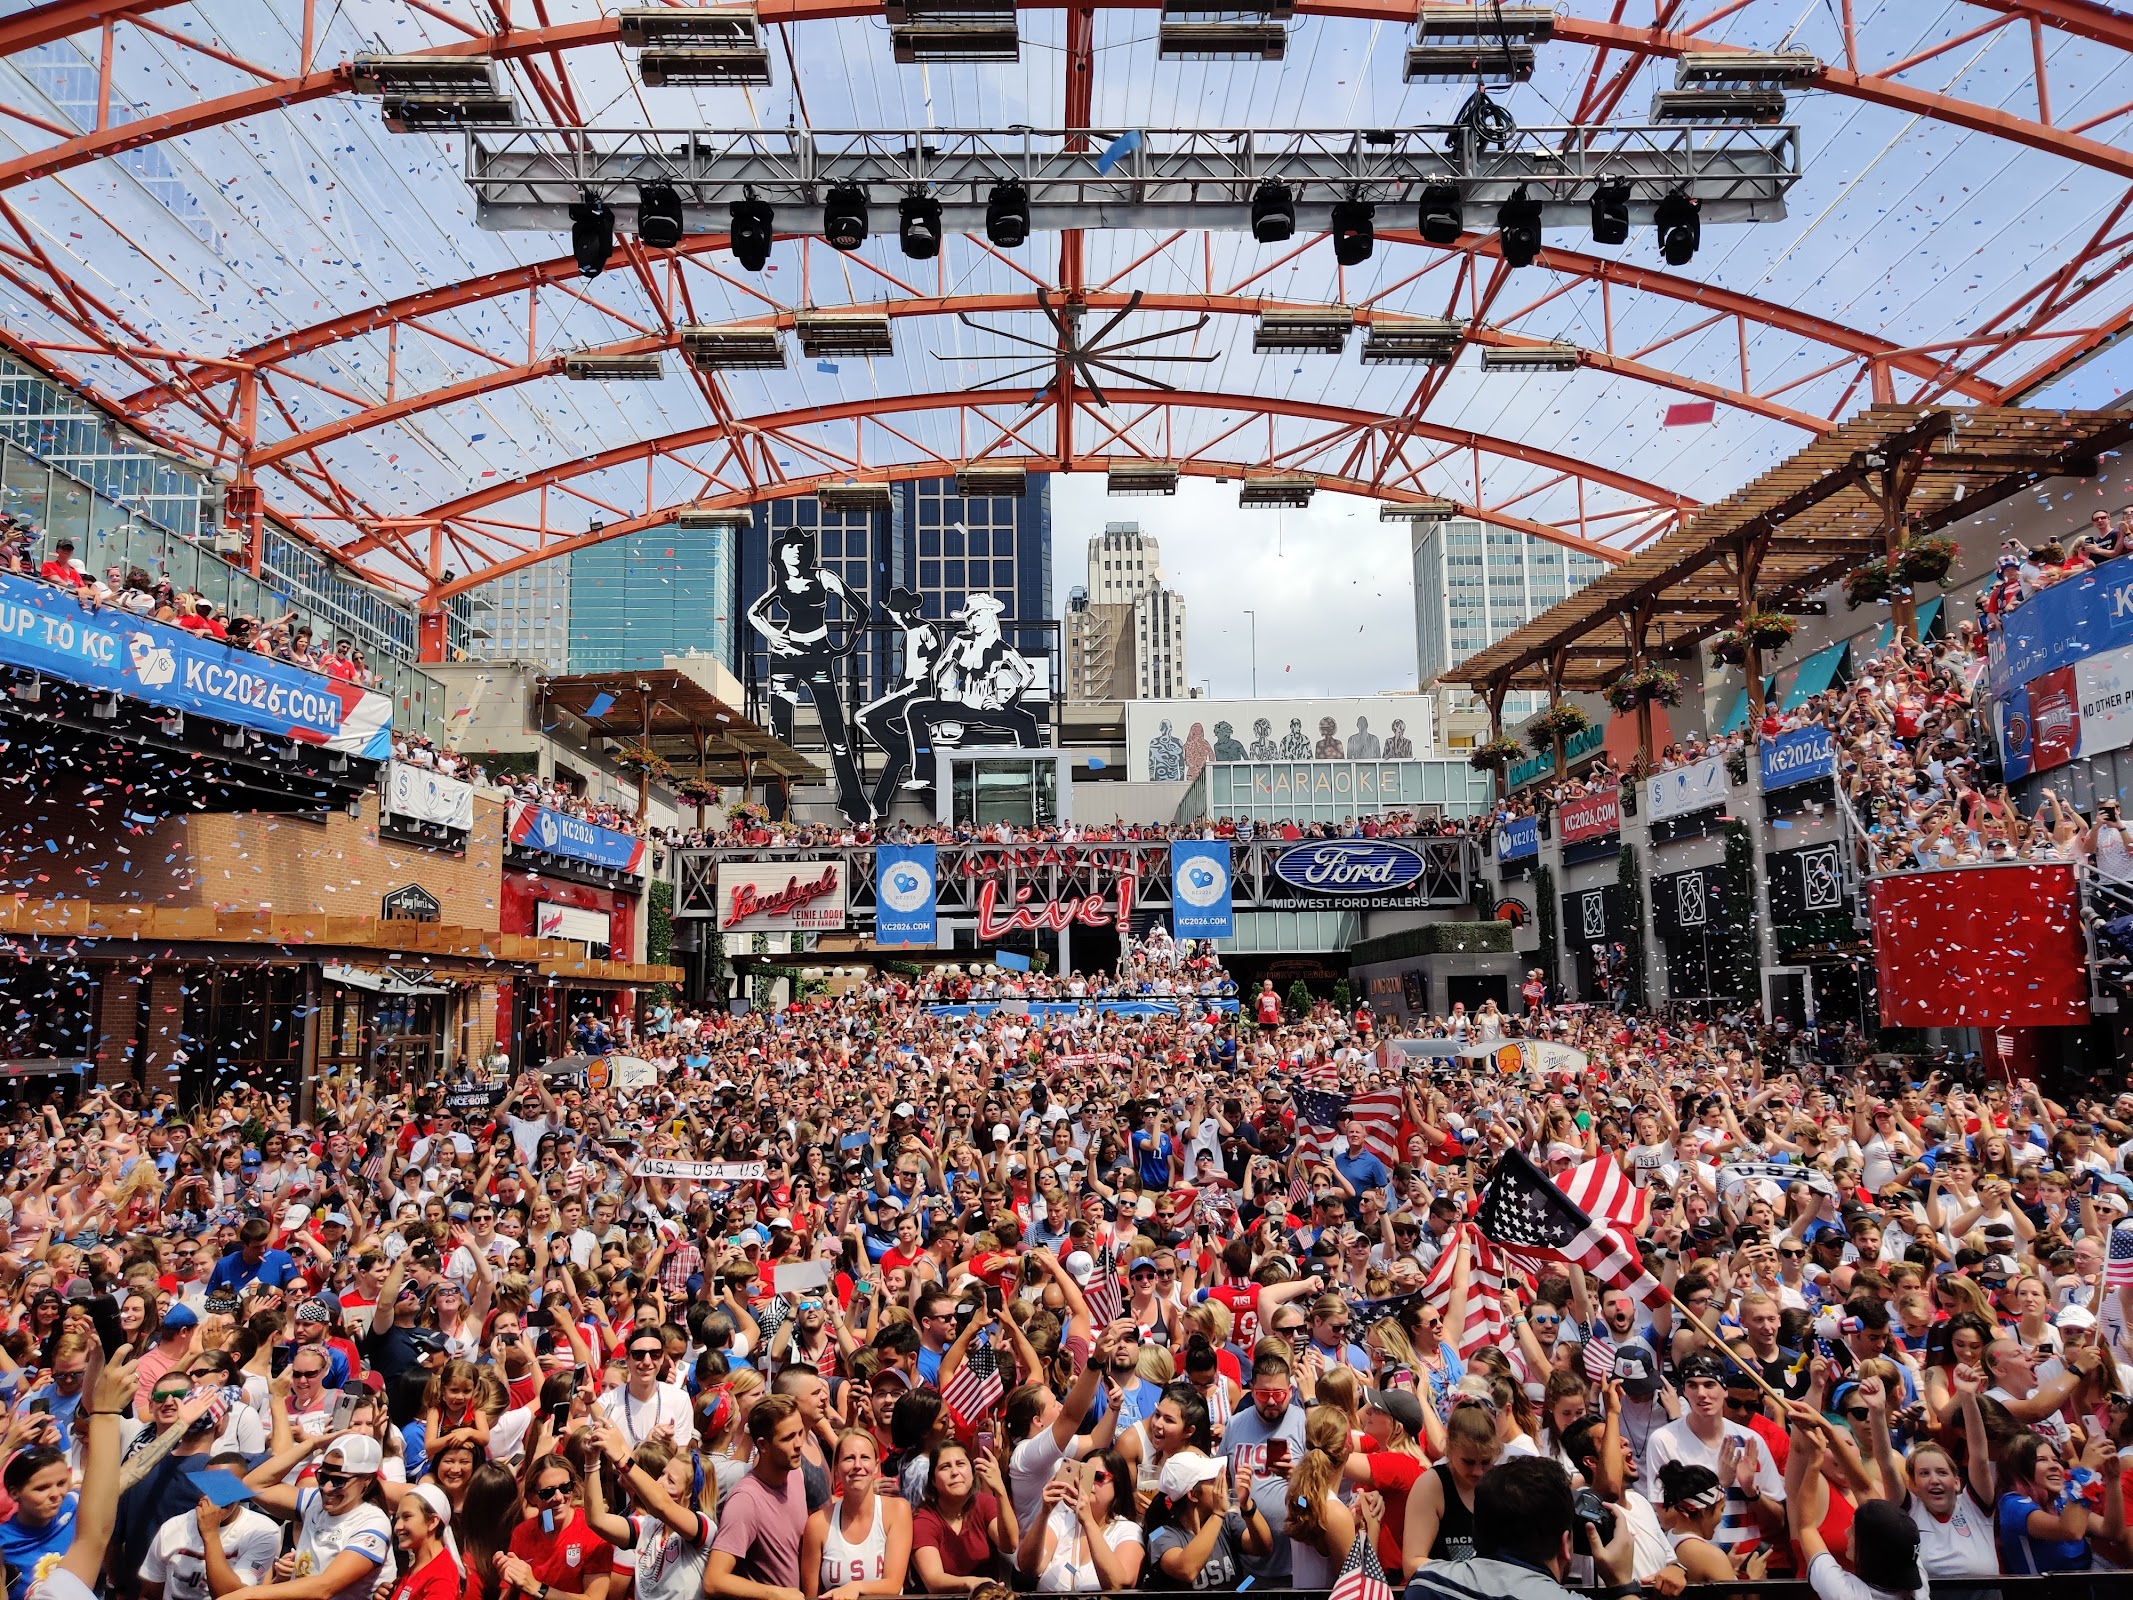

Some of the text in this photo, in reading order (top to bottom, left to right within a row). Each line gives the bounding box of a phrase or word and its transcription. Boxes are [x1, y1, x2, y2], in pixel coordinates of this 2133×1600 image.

[0, 603, 115, 661] UP TO KC
[2016, 656, 2031, 672] CUP
[186, 657, 337, 728] KC2026.COM
[2083, 703, 2094, 719] NO
[2095, 695, 2122, 713] OTHER
[1255, 770, 1398, 794] KARAOKE
[562, 819, 595, 845] KC2026
[1564, 807, 1616, 833] KC2026.COM
[962, 846, 1151, 877] KANSAS CITY
[1305, 846, 1398, 885] Ford
[792, 909, 844, 920] LEINIE LODGE
[978, 875, 1136, 940] Live!
[1272, 897, 1430, 909] MIDWEST FORD DEALERS
[881, 922, 931, 931] KC2026.COM
[1179, 917, 1227, 926] KC2026.COM
[643, 1162, 676, 1175] USA
[692, 1164, 724, 1177] USA
[1734, 1166, 1810, 1181] USA
[2109, 1324, 2121, 1347] 7
[1234, 1442, 1280, 1480] US
[829, 1555, 884, 1584] USA
[1192, 1555, 1236, 1591] USA
